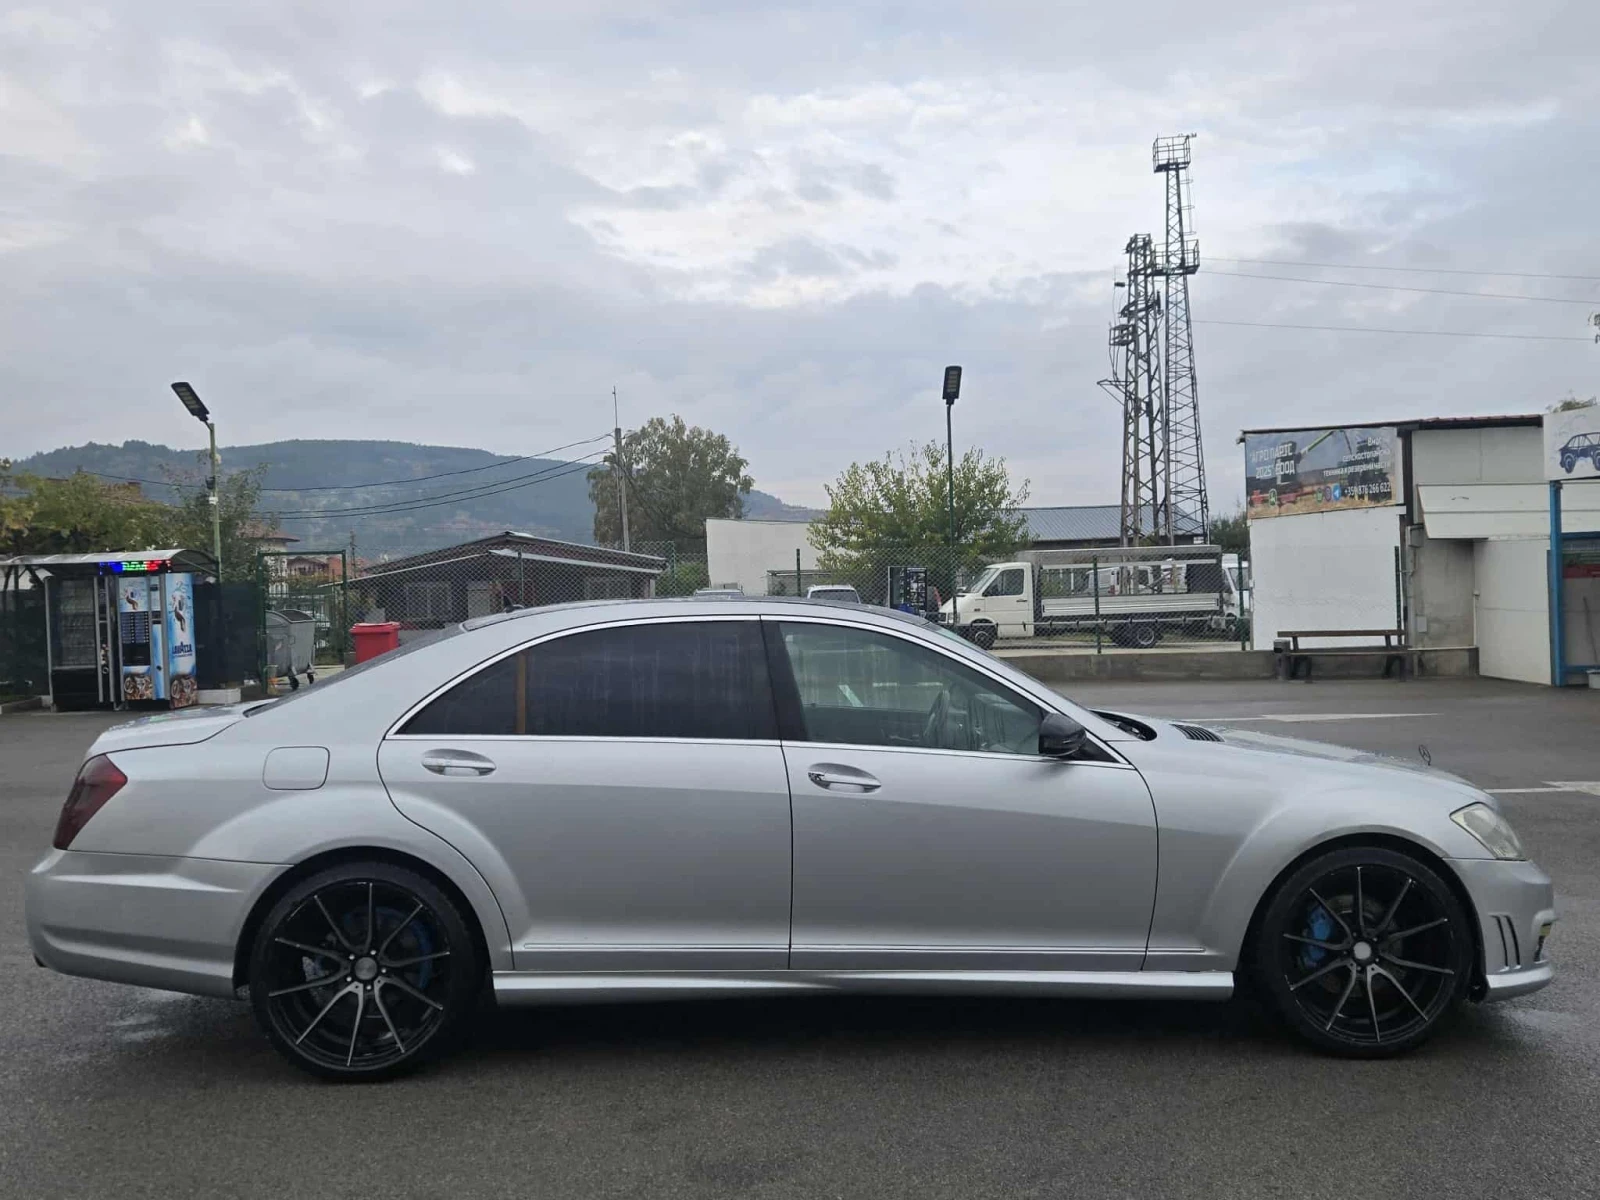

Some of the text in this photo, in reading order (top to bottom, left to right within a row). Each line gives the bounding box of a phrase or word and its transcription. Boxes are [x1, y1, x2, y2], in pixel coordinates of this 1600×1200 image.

[1271, 443, 1293, 459] ПАРТС
[1276, 460, 1296, 476] ЕООД
[1380, 481, 1391, 493] 622
